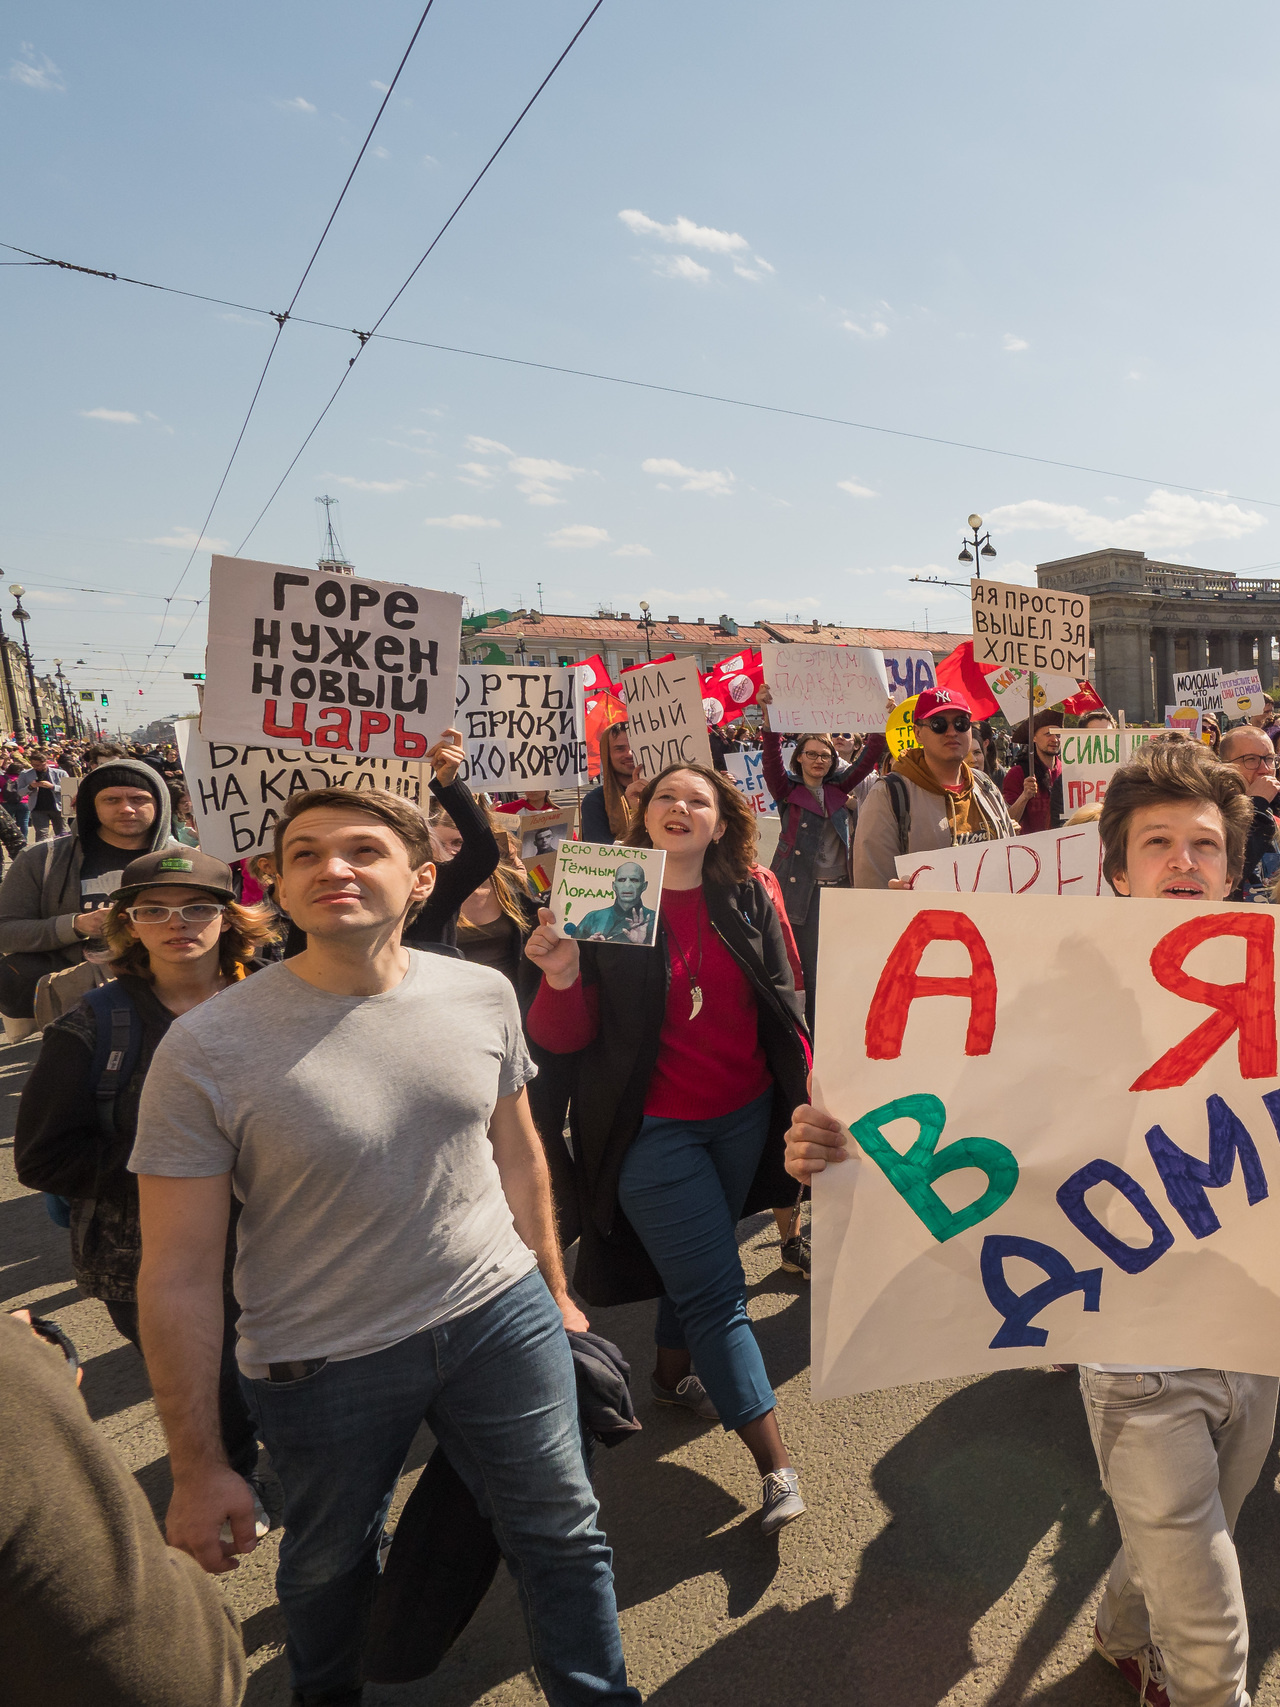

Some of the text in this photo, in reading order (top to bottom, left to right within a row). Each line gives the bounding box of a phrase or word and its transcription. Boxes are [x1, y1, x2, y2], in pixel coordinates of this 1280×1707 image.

[972, 585, 1084, 618] А Я ПРОСТО
[975, 610, 1085, 648] ВЫШЕЛ ЗА
[776, 651, 788, 668] С
[983, 637, 1086, 676] ХЛЕБОМ
[251, 662, 428, 714] НОВЫЙ
[465, 710, 577, 742] БРЮКИ
[778, 710, 889, 728] НЕ ПУСТИЛИ
[509, 741, 588, 780] КОРОЧЕ
[1062, 733, 1120, 765] СИЛЫ
[197, 772, 249, 816] НА
[561, 843, 648, 860] ВСЮ ВЛАСТЬ
[864, 908, 1279, 1093] А Я
[848, 1092, 1020, 1243] В
